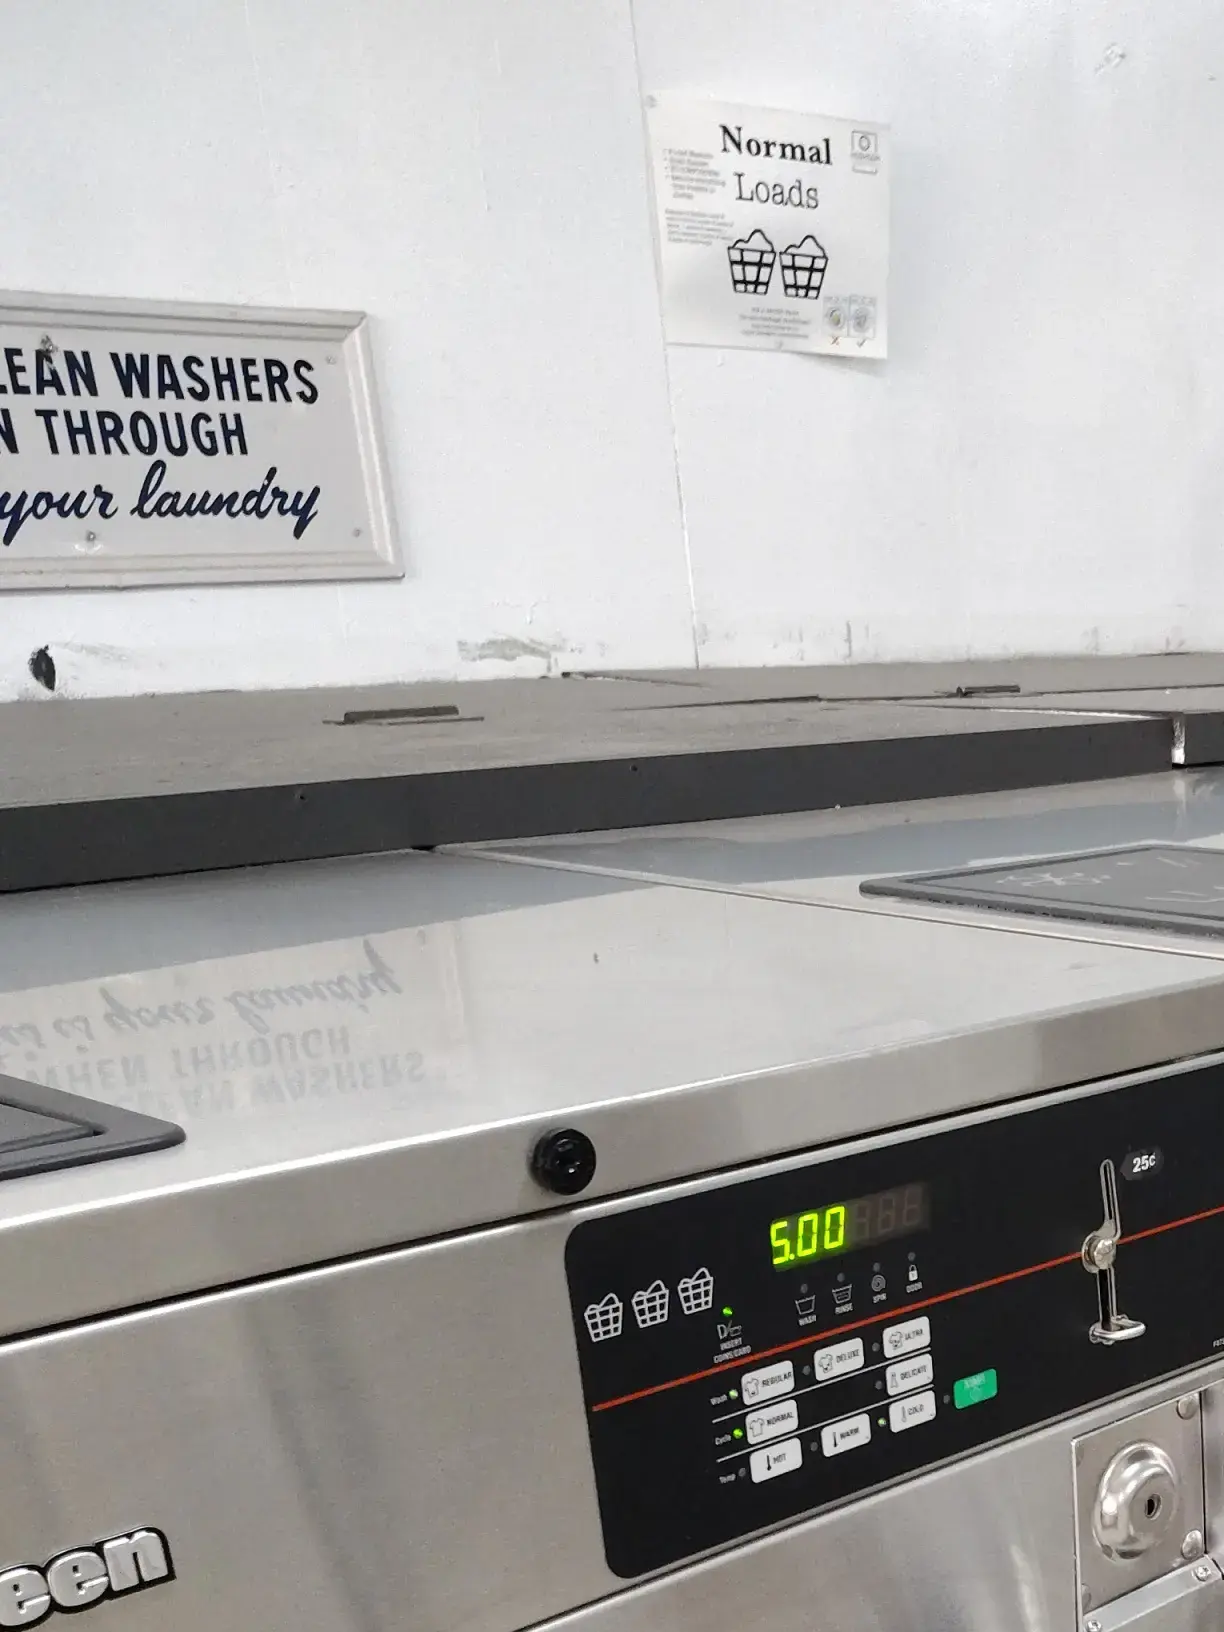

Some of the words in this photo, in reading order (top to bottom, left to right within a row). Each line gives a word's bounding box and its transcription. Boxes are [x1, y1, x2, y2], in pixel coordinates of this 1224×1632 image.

[719, 123, 833, 166] Normal
[733, 170, 819, 210] Loads
[0, 347, 99, 397] EAN
[109, 352, 320, 405] WASHERS
[34, 408, 249, 457] THROUGH
[0, 483, 118, 546] your
[130, 459, 320, 540] laundry
[769, 1205, 846, 1266] 5.00
